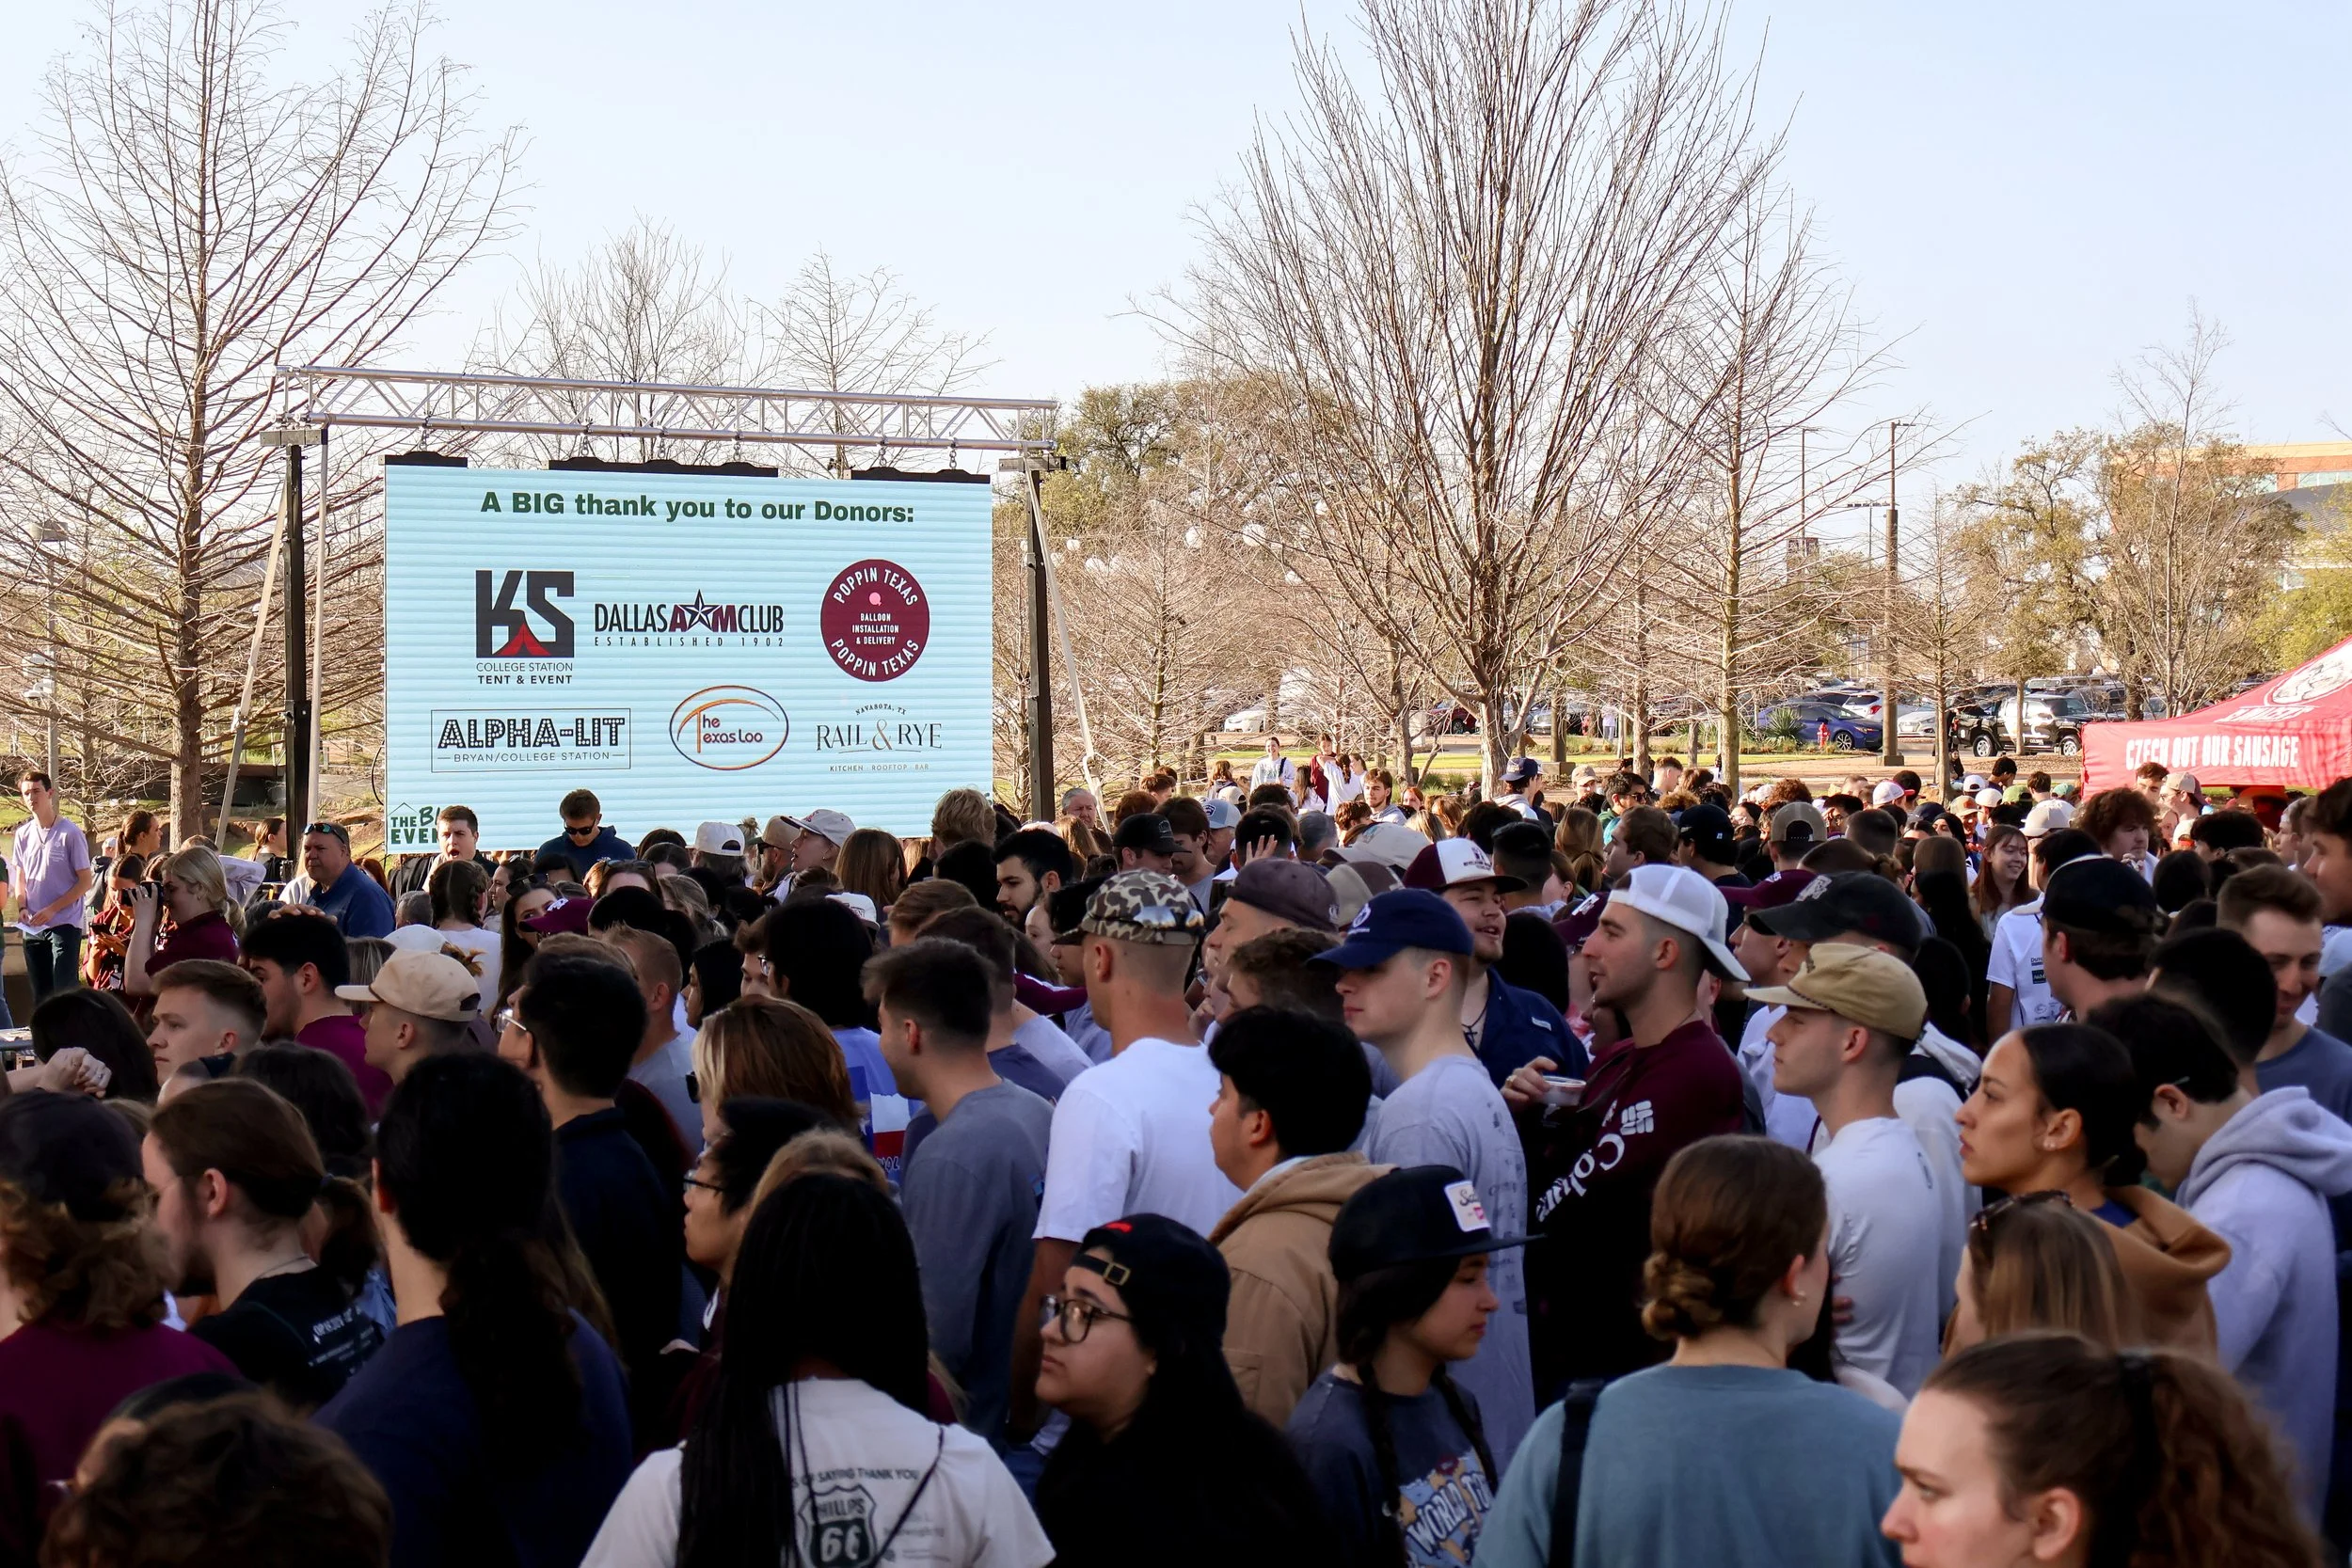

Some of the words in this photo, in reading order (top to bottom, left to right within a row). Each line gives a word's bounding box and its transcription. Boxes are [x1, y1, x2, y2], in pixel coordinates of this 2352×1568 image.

[480, 491, 501, 513] A
[512, 493, 564, 515] BIG
[574, 494, 657, 516] thank
[665, 500, 715, 522] you
[724, 499, 752, 518] to
[761, 503, 805, 520] our
[815, 501, 914, 523] Donors:
[833, 567, 878, 604] POPPIN
[883, 569, 918, 606] TEXAS
[860, 613, 892, 622] BALLOON
[851, 625, 899, 633] INSTALLATION
[595, 637, 723, 647] ESTABLISHED
[741, 638, 784, 647] 1902
[864, 637, 896, 645] DELIVERY
[831, 639, 877, 677] POPPIN
[881, 640, 919, 675] TEXAS
[476, 662, 526, 673] COLLEGE
[529, 662, 573, 673] STATION
[478, 675, 511, 685] TENT
[516, 675, 525, 685] &
[530, 675, 572, 685] EVENT
[897, 706, 907, 716] TX
[437, 718, 626, 750] ALPHA-LIT
[739, 729, 763, 743] Loo
[816, 724, 867, 752] RAIL
[871, 719, 893, 751] &
[898, 723, 943, 749] RYE
[453, 752, 555, 763] BRYAN/COLLEGE
[561, 752, 610, 762] STATION
[2125, 737, 2169, 770] CZECH
[2171, 736, 2199, 768] OUT
[2201, 735, 2230, 767] OUR
[2233, 735, 2299, 768] SAUSAGE
[390, 816, 416, 827] THE
[419, 806, 440, 827] BI
[390, 828, 437, 845] EVE
